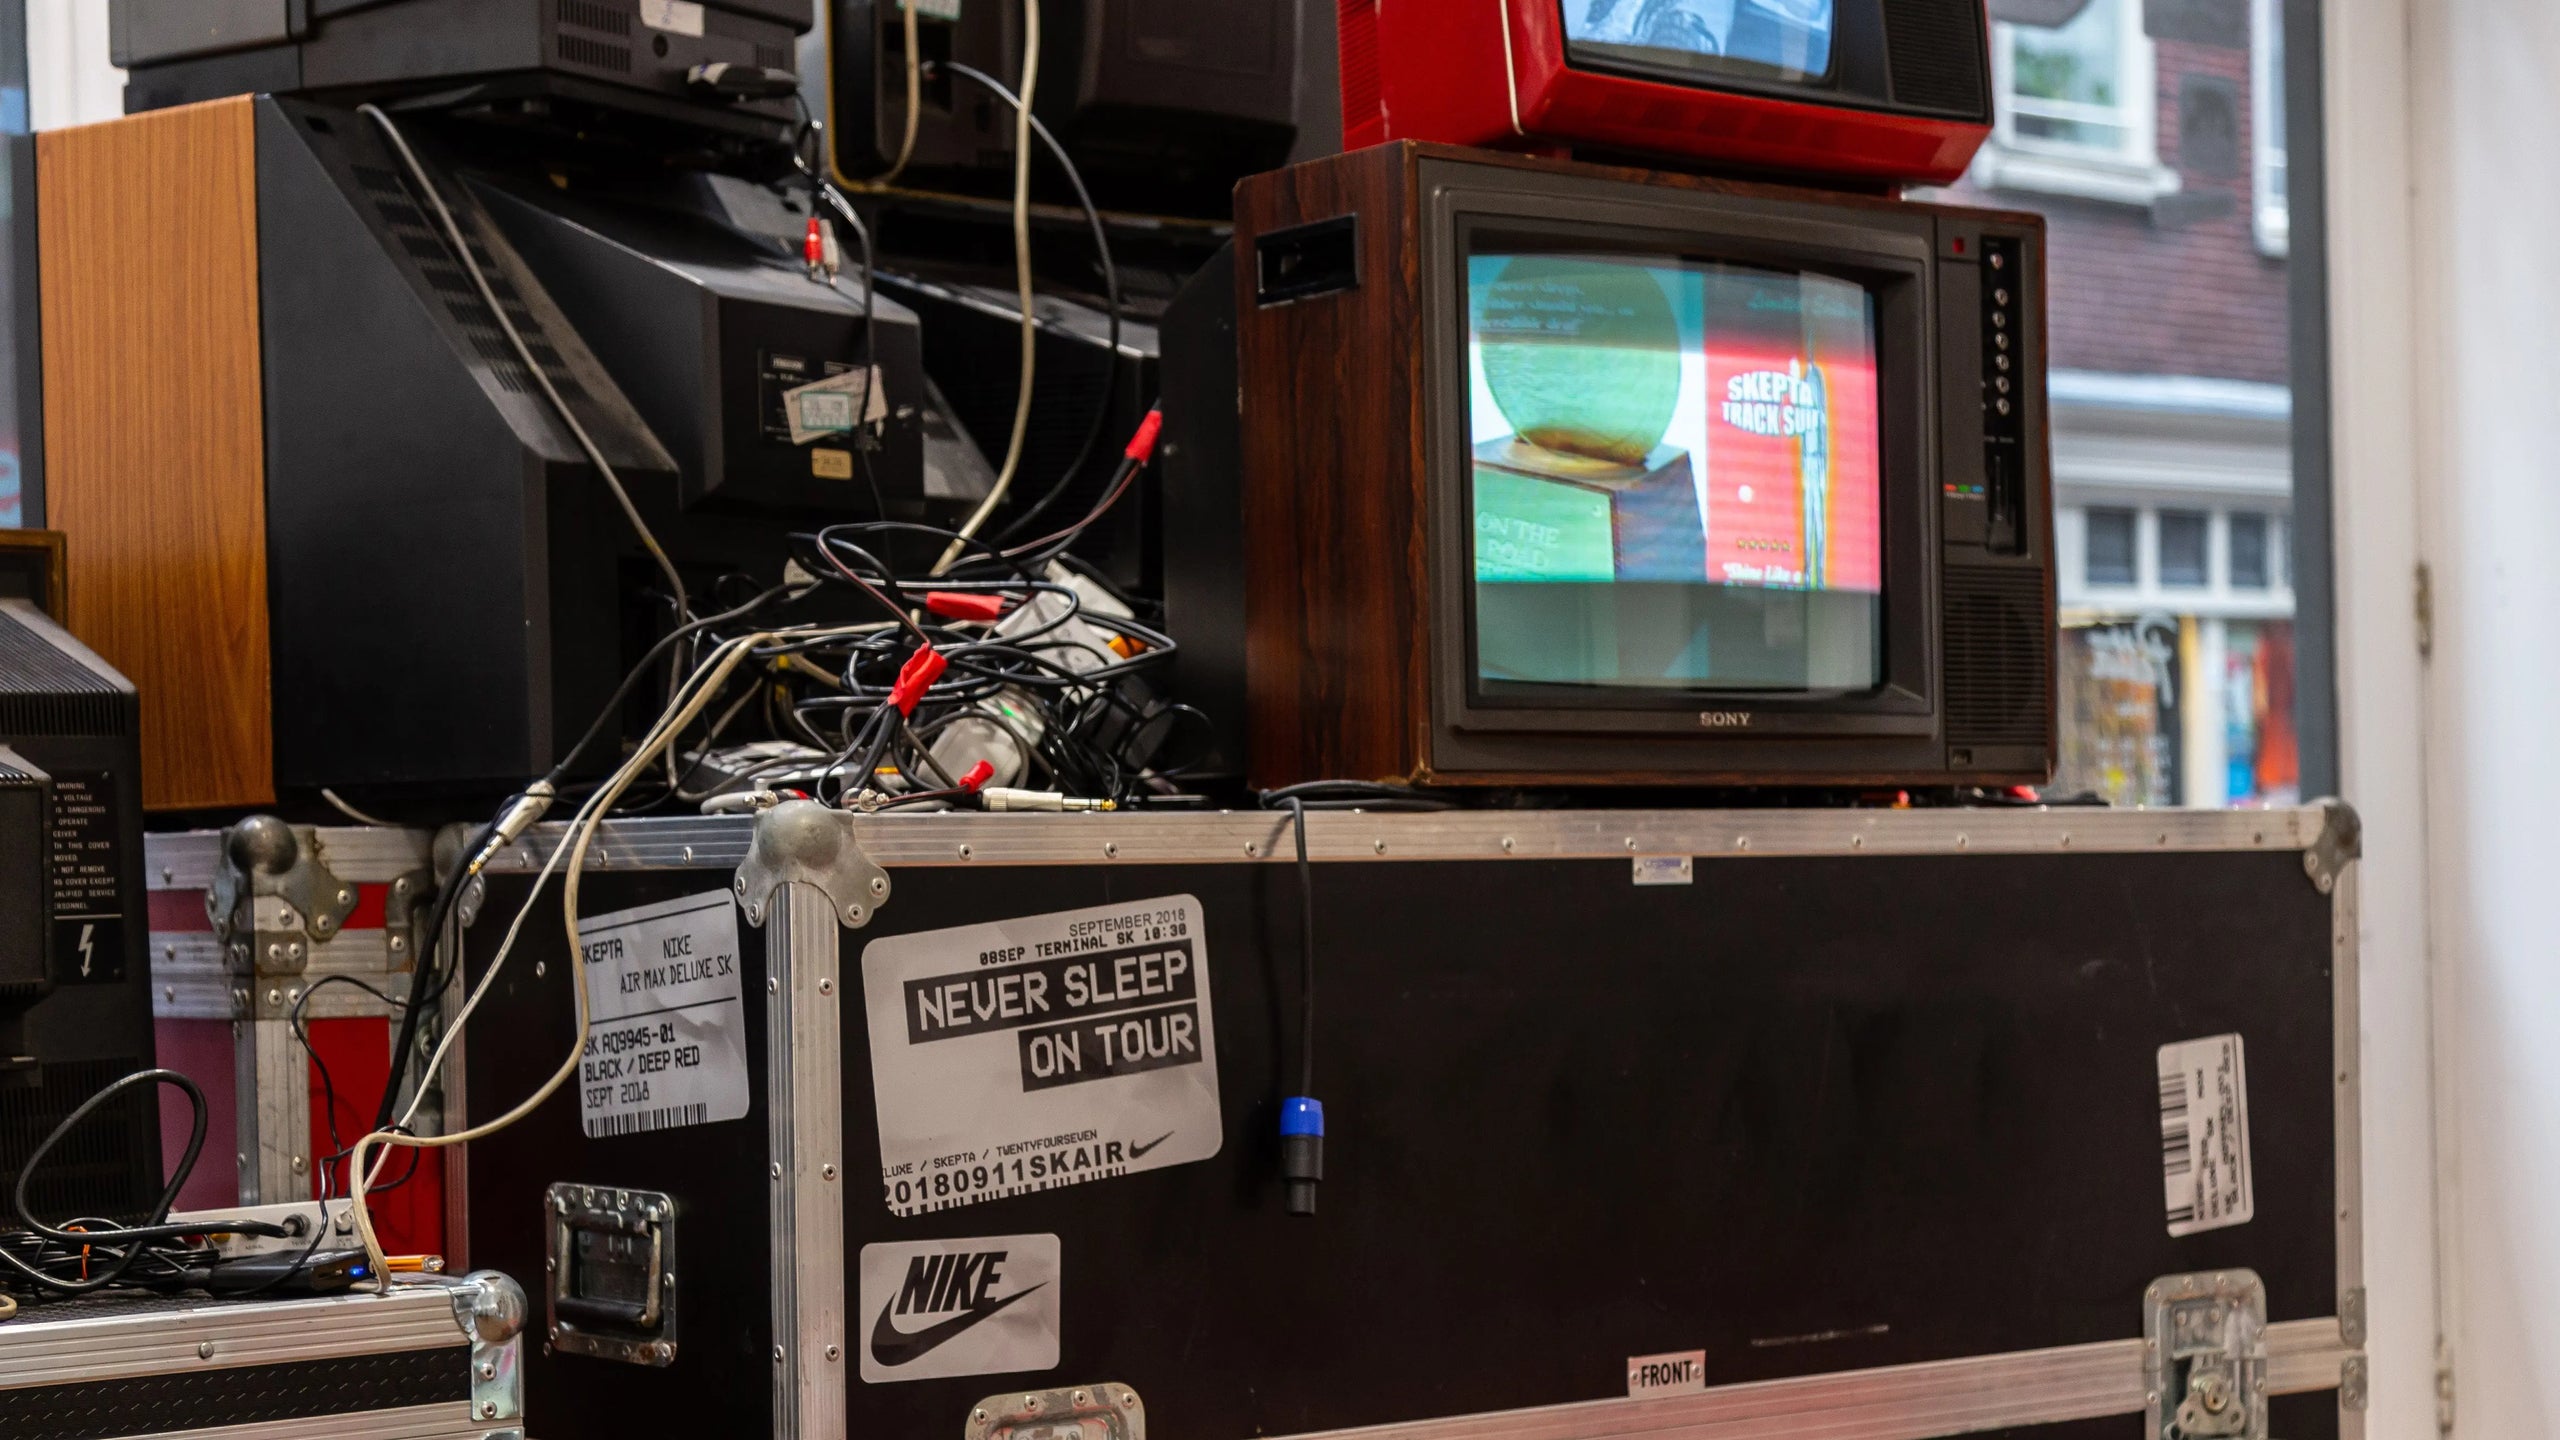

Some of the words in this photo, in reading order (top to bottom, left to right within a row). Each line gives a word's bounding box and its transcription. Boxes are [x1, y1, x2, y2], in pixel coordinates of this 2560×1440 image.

[1728, 372, 1813, 406] SKEPTA
[1722, 401, 1780, 435] TRACK
[1477, 512, 1509, 535] ON
[1513, 518, 1560, 548] THE
[1699, 712, 1751, 726] SONY
[80, 865, 105, 873] REMOVE
[90, 877, 115, 885] EXCEPT
[1069, 913, 1152, 937] SEPTEMBER
[1156, 909, 1186, 924] 2018
[663, 935, 692, 958] NIKE
[980, 948, 1025, 965] 08SEP
[1036, 935, 1108, 958] TERMINAL
[1117, 930, 1134, 945] SK
[1144, 923, 1187, 941] 10:30
[620, 972, 641, 994] AIR
[644, 966, 666, 990] MAX
[670, 960, 713, 985] DELUXE
[718, 954, 733, 975] SK
[918, 971, 1049, 1031] NEVER
[1064, 950, 1187, 1007] SLEEP
[584, 1035, 598, 1056] SK
[1029, 1031, 1081, 1078] ON
[1095, 1013, 1195, 1066] TOUR
[584, 1058, 623, 1082] BLACK
[627, 1059, 635, 1074] /
[639, 1050, 671, 1074] DEEP
[675, 1046, 700, 1068] RED
[586, 1086, 613, 1109] SEPT
[621, 1082, 649, 1104] 2018
[920, 1160, 927, 1172] /
[934, 1152, 976, 1168] SKEPTA
[983, 1149, 989, 1160] /
[996, 1129, 1098, 1157] TWENTYFOURSEVEN
[884, 1141, 1124, 1206] 20180911SKAIR
[895, 1251, 1008, 1315] NIKE
[1641, 1360, 1692, 1388] FRONT
